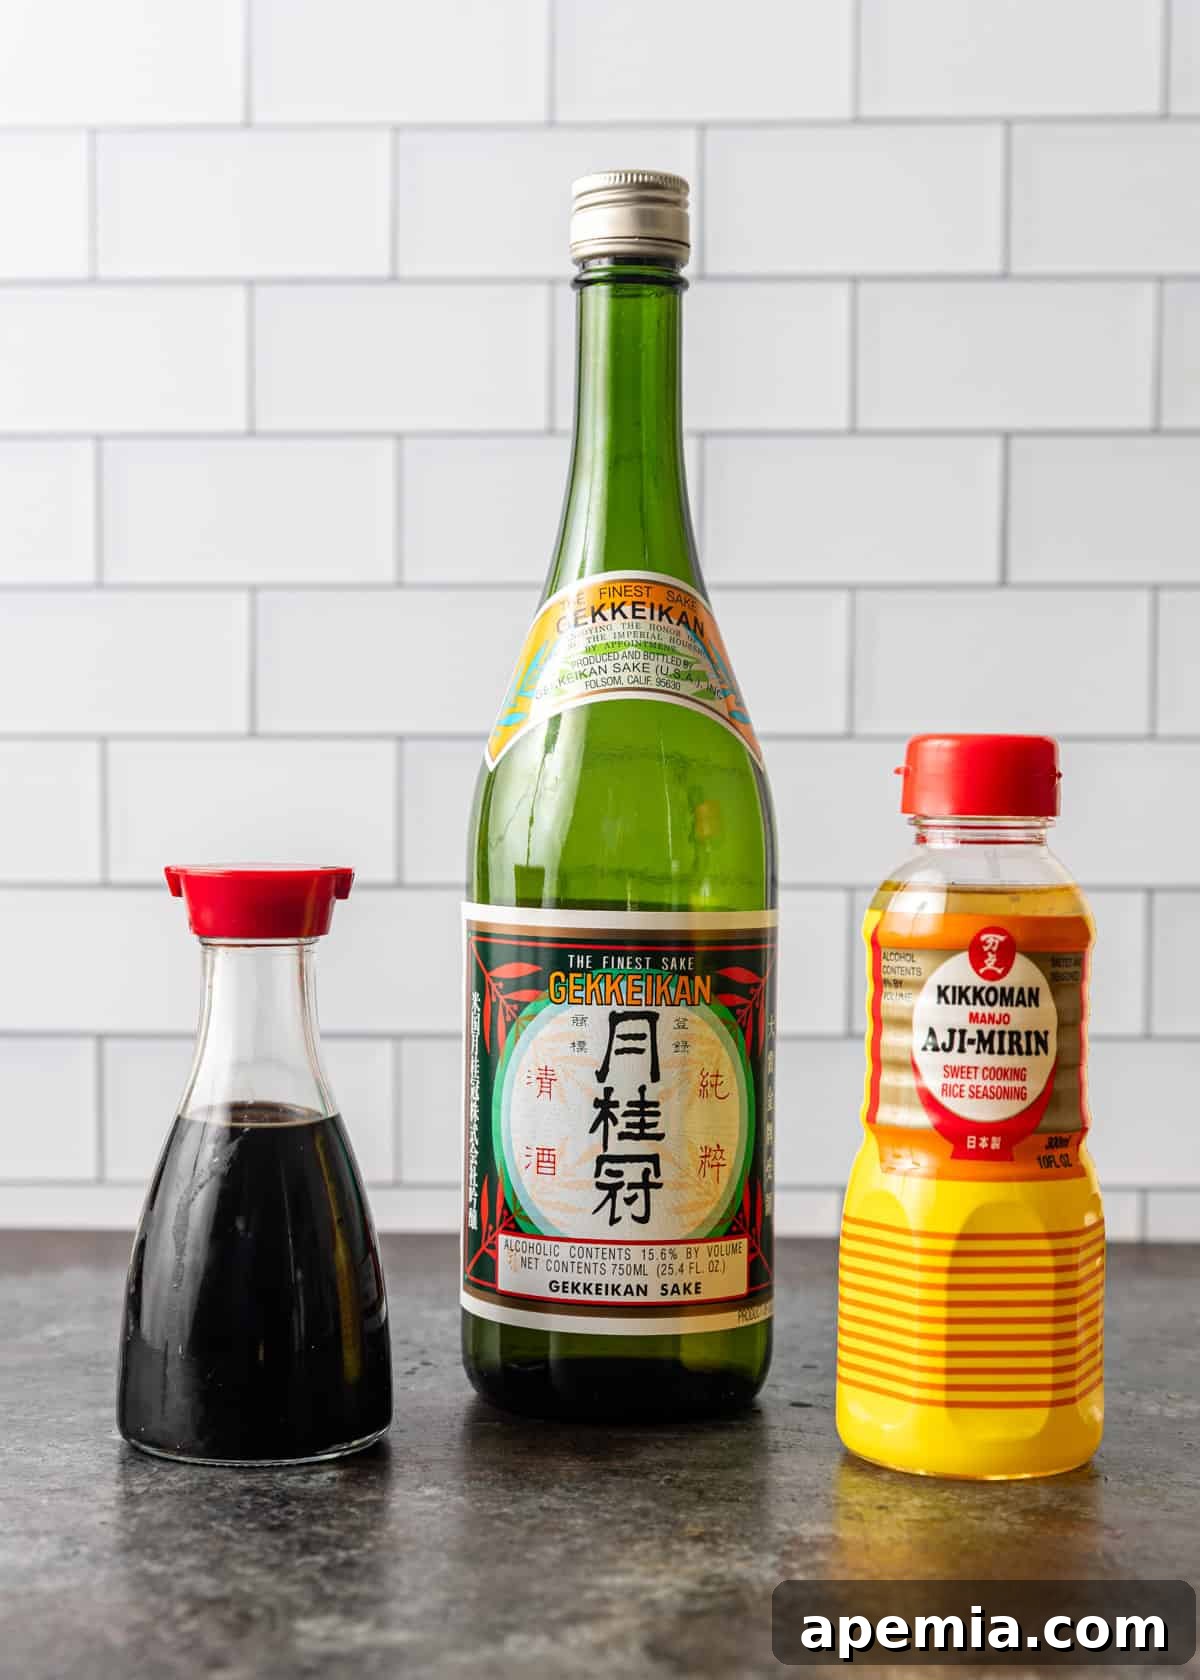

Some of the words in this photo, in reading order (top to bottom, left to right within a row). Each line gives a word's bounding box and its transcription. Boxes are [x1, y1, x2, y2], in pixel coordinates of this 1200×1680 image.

[560, 591, 585, 611] TE
[599, 585, 653, 600] FINEST
[666, 590, 698, 609] SAKE
[555, 600, 704, 637] GEKKEIKAN
[612, 628, 664, 643] IMPERIAL
[622, 620, 641, 631] THE
[649, 622, 681, 637] HONOR
[621, 649, 641, 661] AND
[643, 650, 682, 667] BOTTLED
[611, 661, 651, 674] SAKE
[584, 675, 624, 690] FOLSOM,
[655, 676, 681, 691] 95630
[567, 954, 593, 969] THE
[602, 955, 651, 969] FINEST
[661, 955, 695, 971] SAKE
[882, 951, 916, 963] ALCOHOL
[882, 964, 922, 977] CONTENTS
[549, 971, 712, 1007] GEKKEIKAN
[936, 984, 1040, 1008] KIKKOMAN
[968, 1012, 1011, 1025] MANJO
[921, 1027, 1050, 1056] AJI-MIRIN
[943, 1064, 979, 1080] SWEET
[981, 1065, 1027, 1082] COOKING
[941, 1083, 965, 1098] RICE
[968, 1084, 1028, 1101] SEASONING
[524, 1064, 558, 1177] 清酒
[588, 1010, 666, 1227] 月桂冠
[966, 1135, 1002, 1150] 日本製
[503, 1239, 560, 1258] ALCOHOLIC
[569, 1245, 631, 1261] CONTENTS
[641, 1247, 678, 1261] 15.6%
[686, 1246, 700, 1260] BY
[707, 1241, 743, 1258] VOLUME
[520, 1256, 539, 1271] NET
[545, 1259, 607, 1276] CONTENTS
[611, 1263, 649, 1277] 750ML
[656, 1262, 684, 1279] (25.4
[688, 1261, 704, 1274] FL.
[548, 1280, 648, 1297] GEKKEIKAN
[660, 1281, 703, 1297] SAKE
